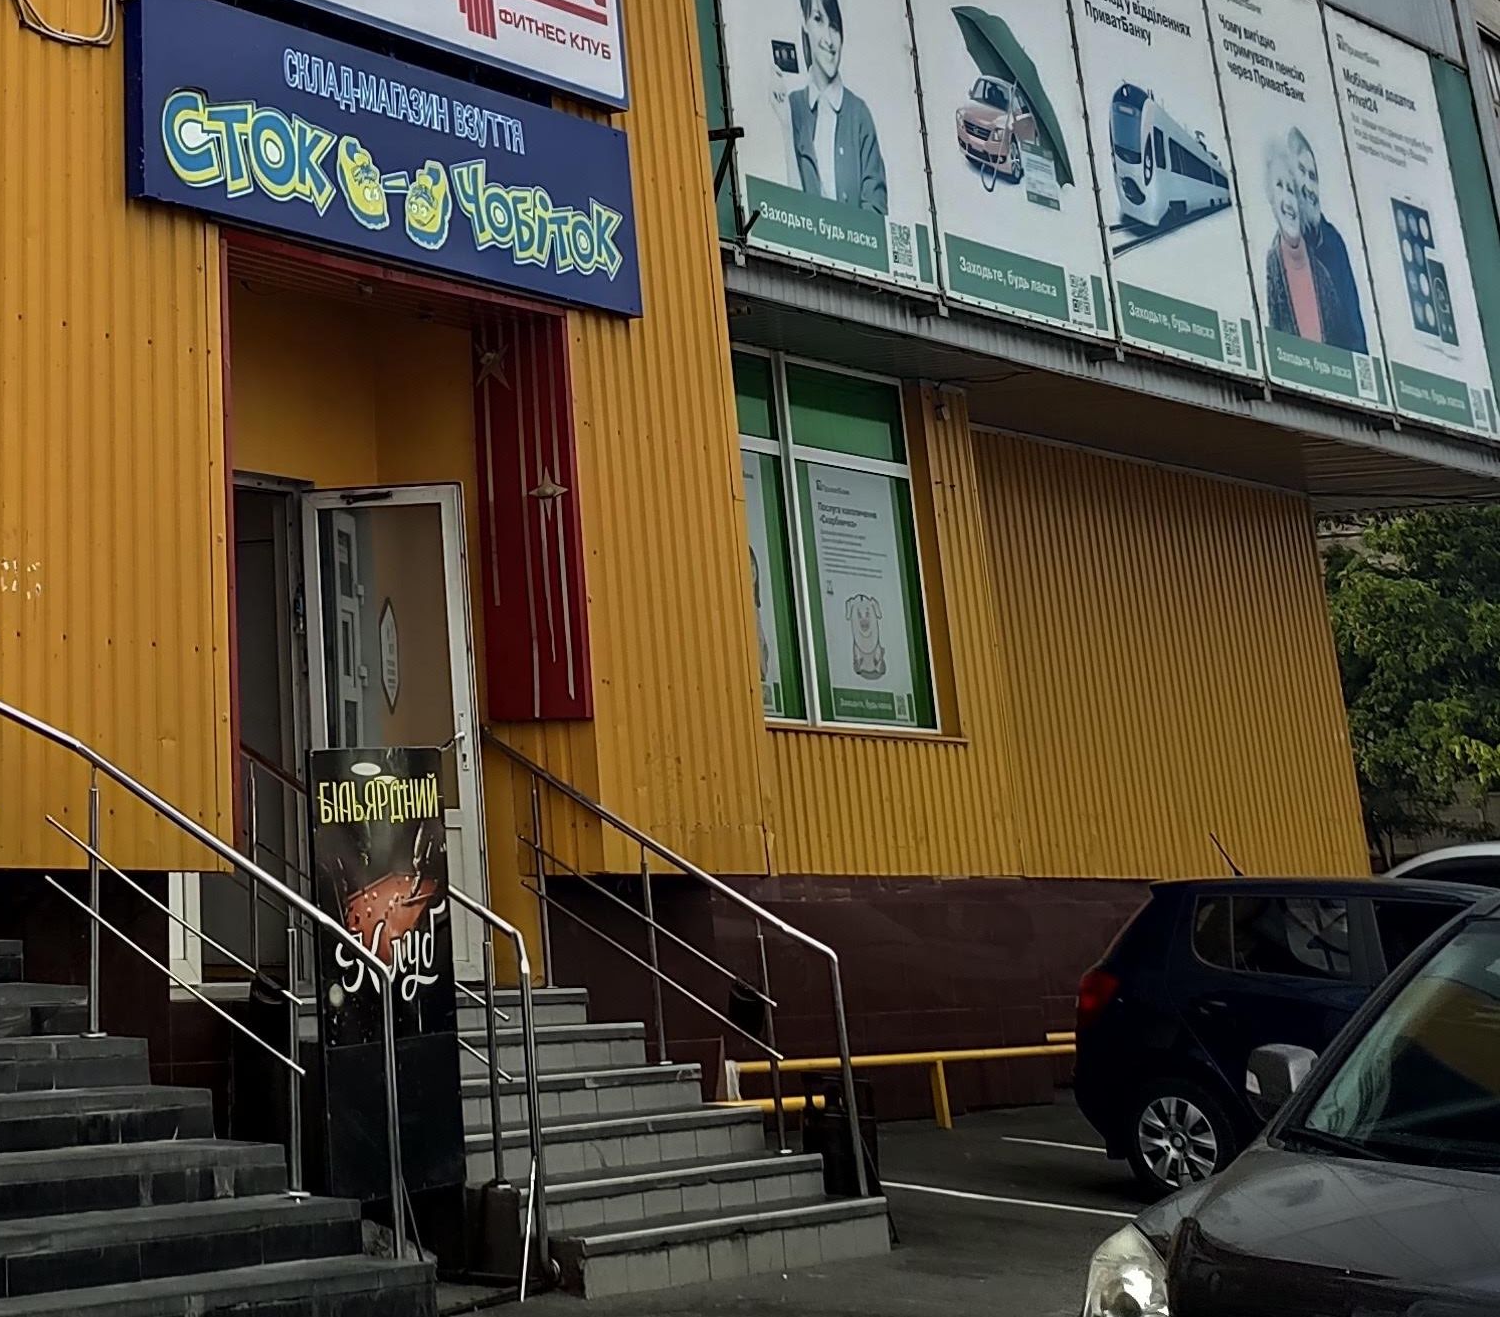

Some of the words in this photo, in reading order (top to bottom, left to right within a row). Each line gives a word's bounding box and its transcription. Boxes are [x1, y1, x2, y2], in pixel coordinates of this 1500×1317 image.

[498, 8, 566, 45] ФИТНЕС
[569, 32, 612, 61] КЛУБ
[282, 47, 449, 134] СКЛАД-МАГАЗИН
[451, 100, 526, 156] ВЗУТТЯ
[161, 87, 338, 217] СТОК
[759, 200, 817, 236] Заходьте,
[818, 219, 846, 243] будь
[846, 229, 878, 250] ласка
[959, 256, 1004, 283] Заходьте,
[1007, 270, 1030, 291] будь
[1030, 278, 1057, 298] ласка
[318, 772, 440, 824] БІЛЬЯРДНИЙ
